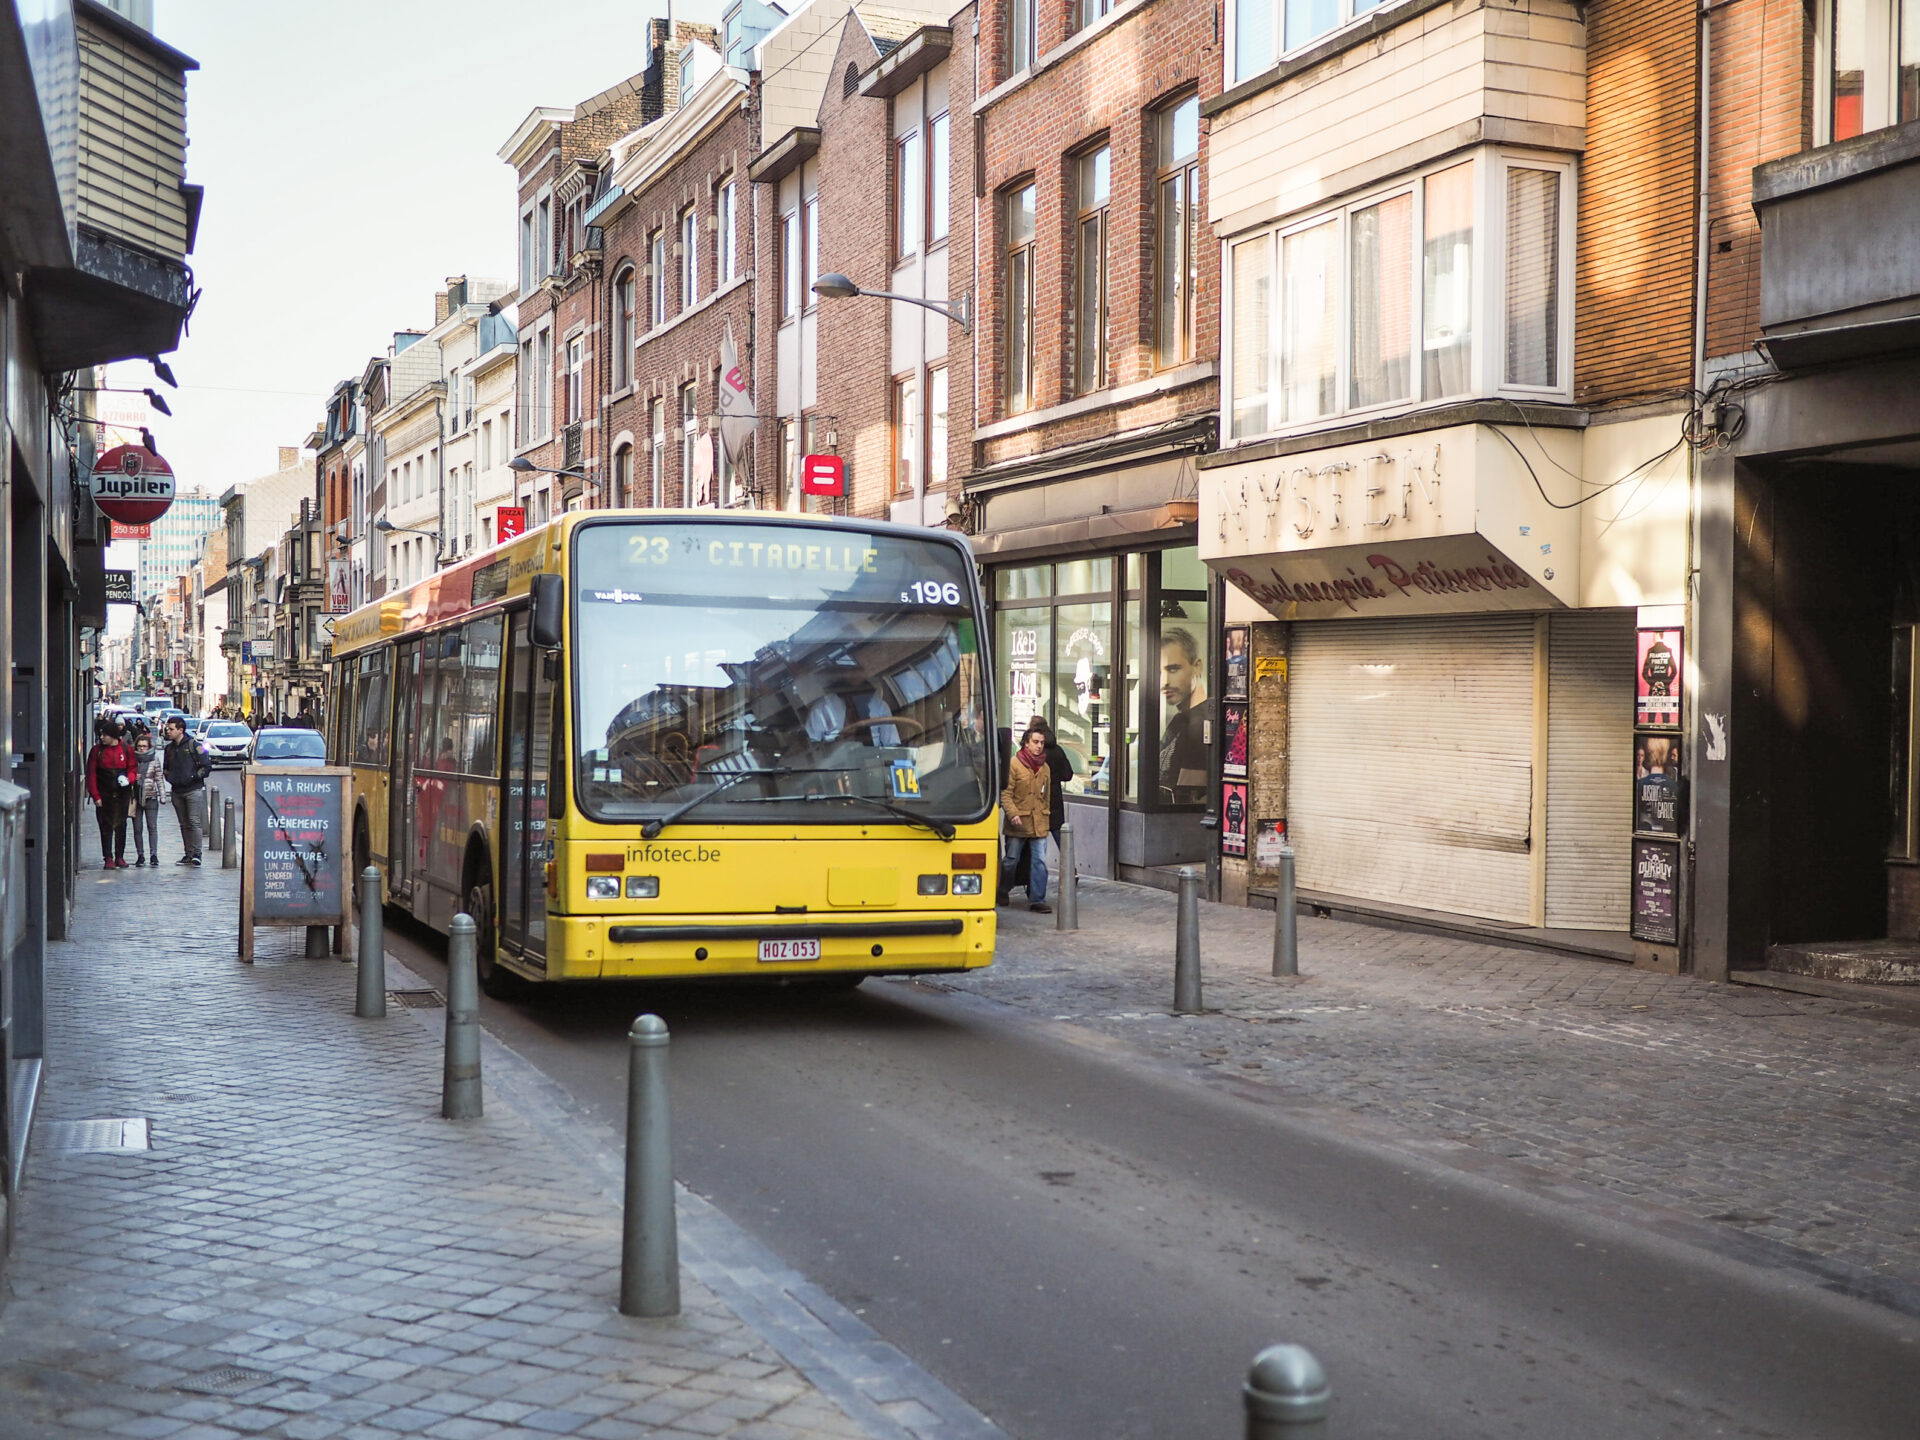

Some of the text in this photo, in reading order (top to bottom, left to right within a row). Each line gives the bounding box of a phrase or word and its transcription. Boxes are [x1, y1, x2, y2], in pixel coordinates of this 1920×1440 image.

[96, 477, 170, 497] Jupiler
[114, 525, 149, 534] 250 59 51
[628, 536, 878, 573] 23 CITADELLE
[263, 781, 283, 793] BAR
[296, 782, 332, 793] RHUMS
[896, 768, 919, 794] 14
[626, 844, 720, 862] infotec.be
